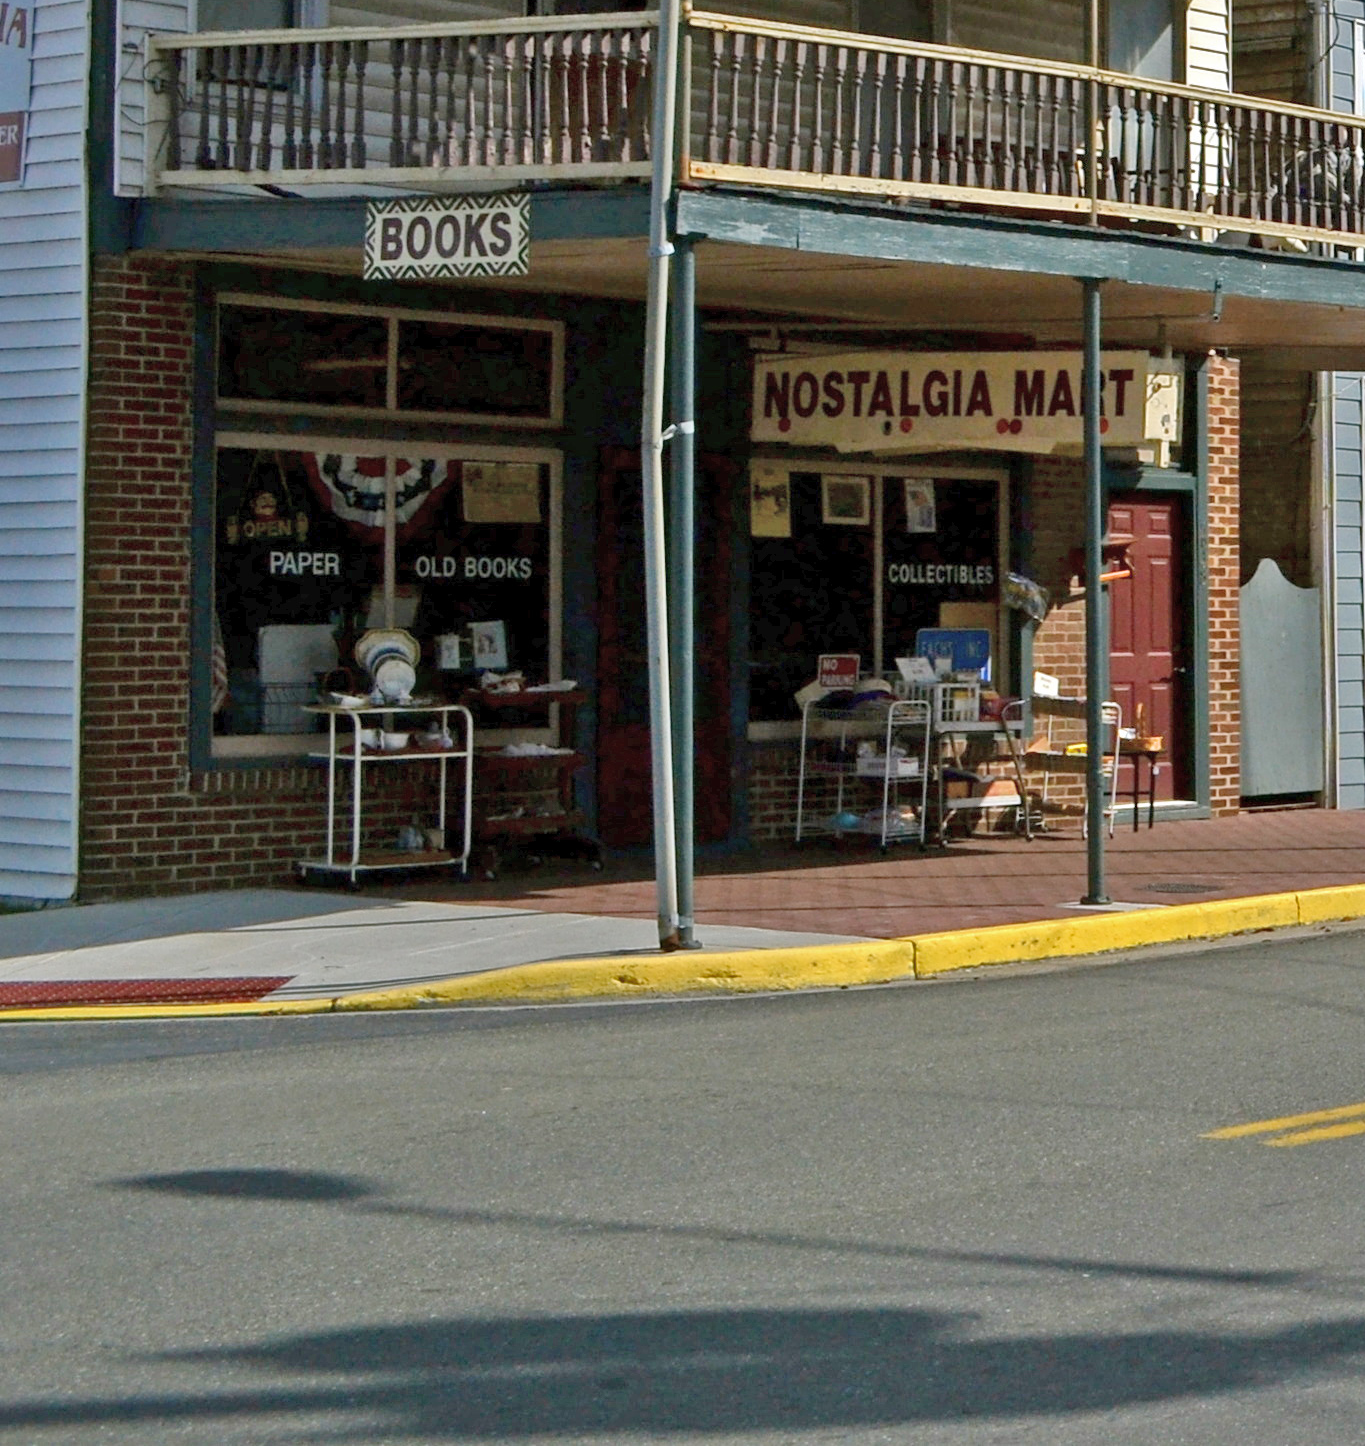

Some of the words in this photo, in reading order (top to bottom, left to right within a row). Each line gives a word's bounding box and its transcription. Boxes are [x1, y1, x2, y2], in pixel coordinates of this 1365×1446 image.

[380, 212, 512, 261] BOOKS
[763, 370, 994, 418] NOSTALGIA
[243, 519, 292, 537] OPEN
[270, 551, 340, 575] PAPER
[416, 556, 456, 578] OLD
[464, 557, 532, 578] BOOKS
[888, 564, 994, 585] COLLECTIBLES
[823, 658, 838, 671] NO
[822, 673, 856, 686] PARKING
